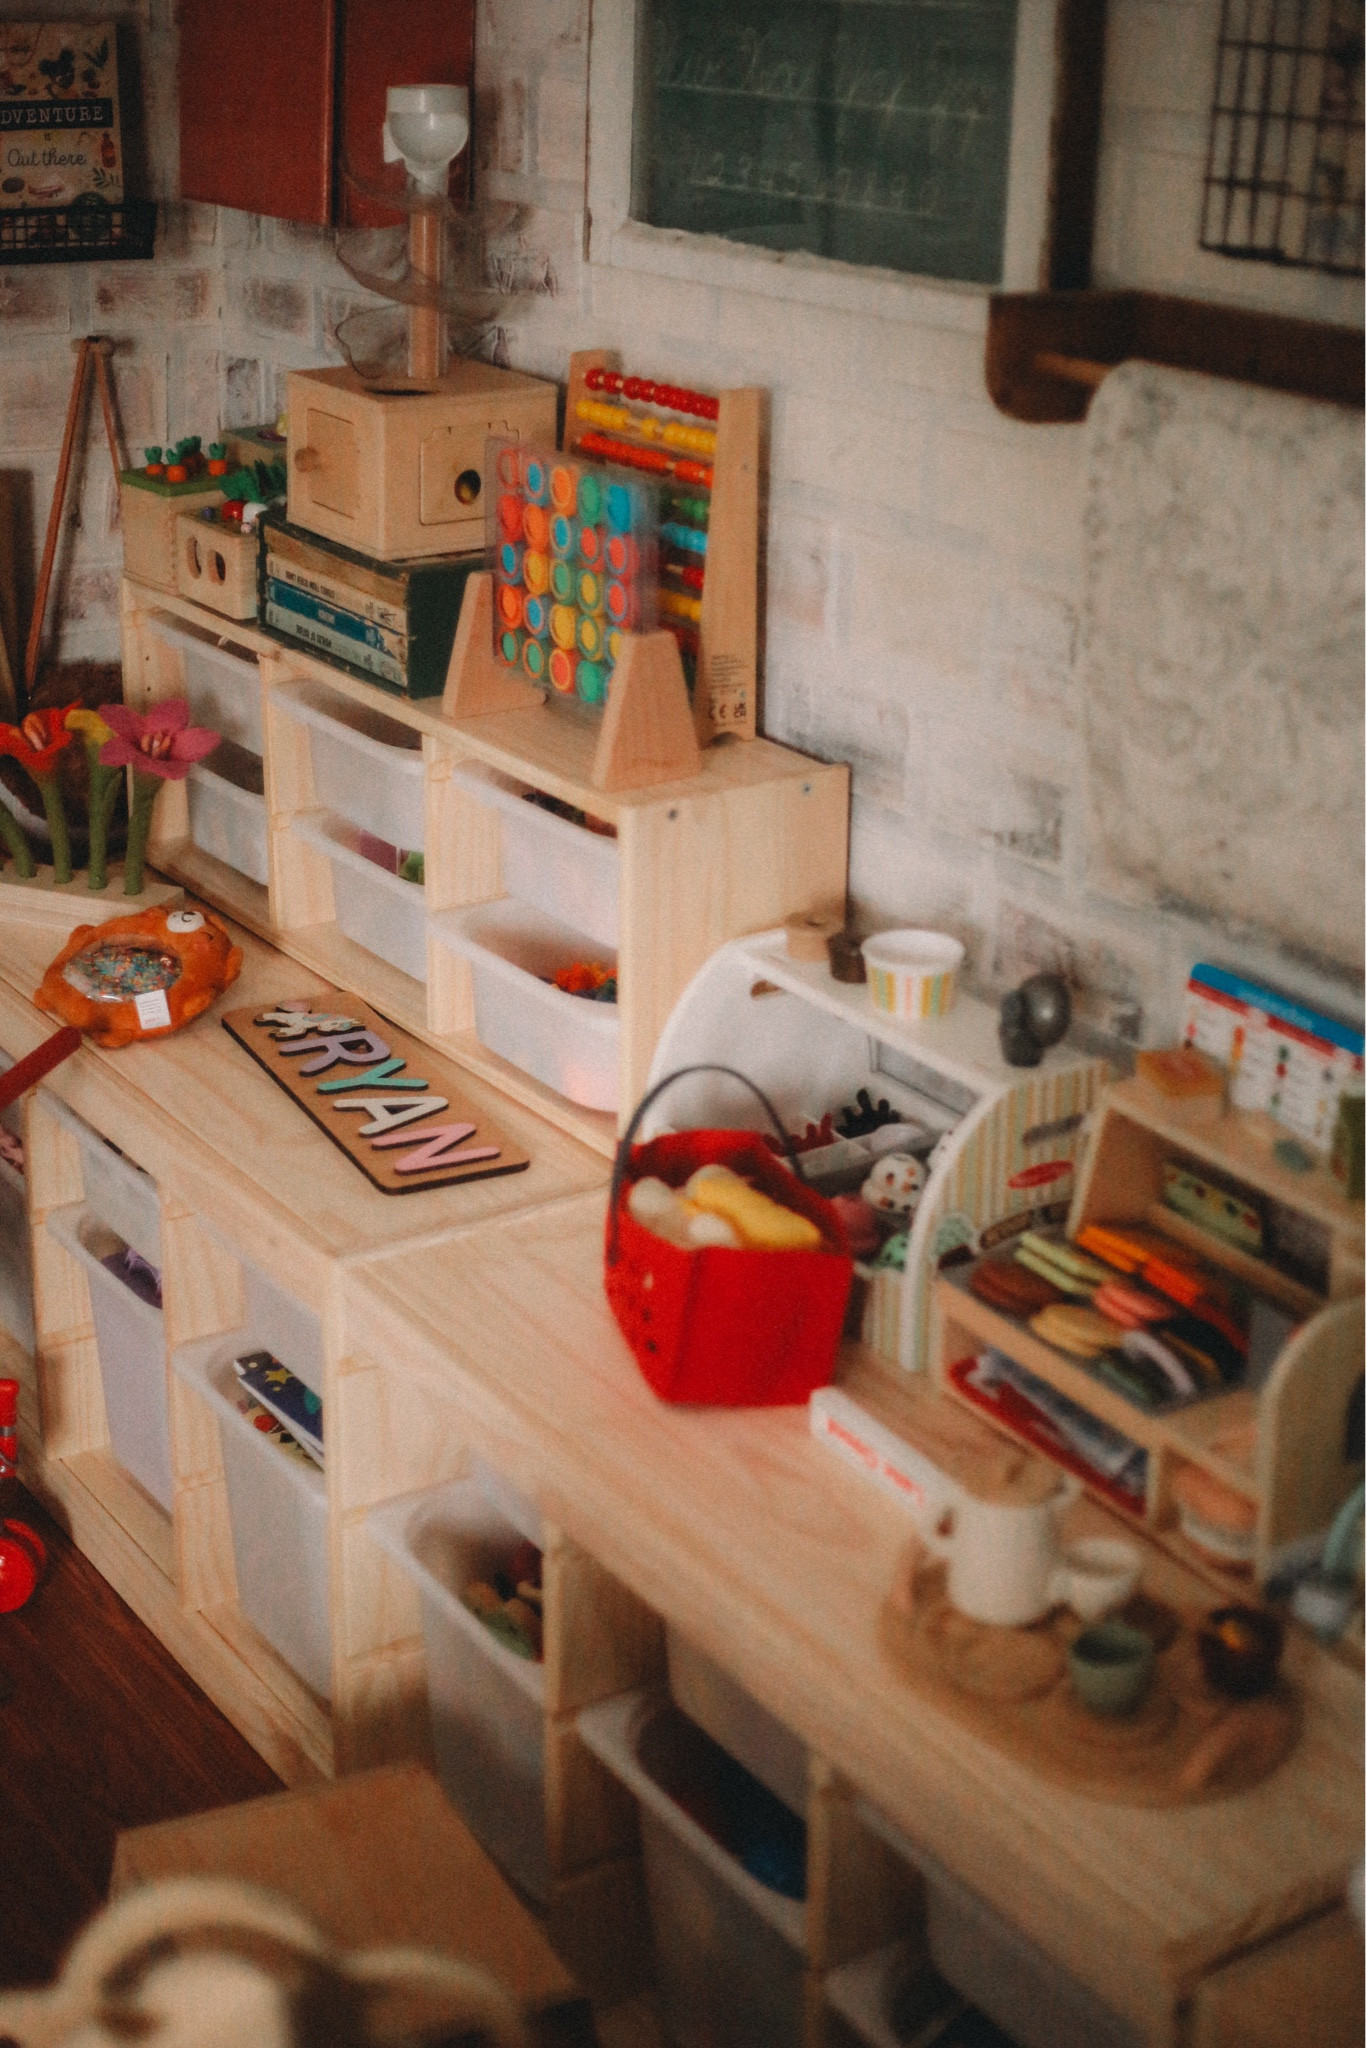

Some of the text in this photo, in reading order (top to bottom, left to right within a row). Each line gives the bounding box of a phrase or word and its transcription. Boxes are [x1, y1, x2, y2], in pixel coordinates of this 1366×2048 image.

[7, 146, 88, 168] Out there
[279, 1029, 501, 1176] RYAN
